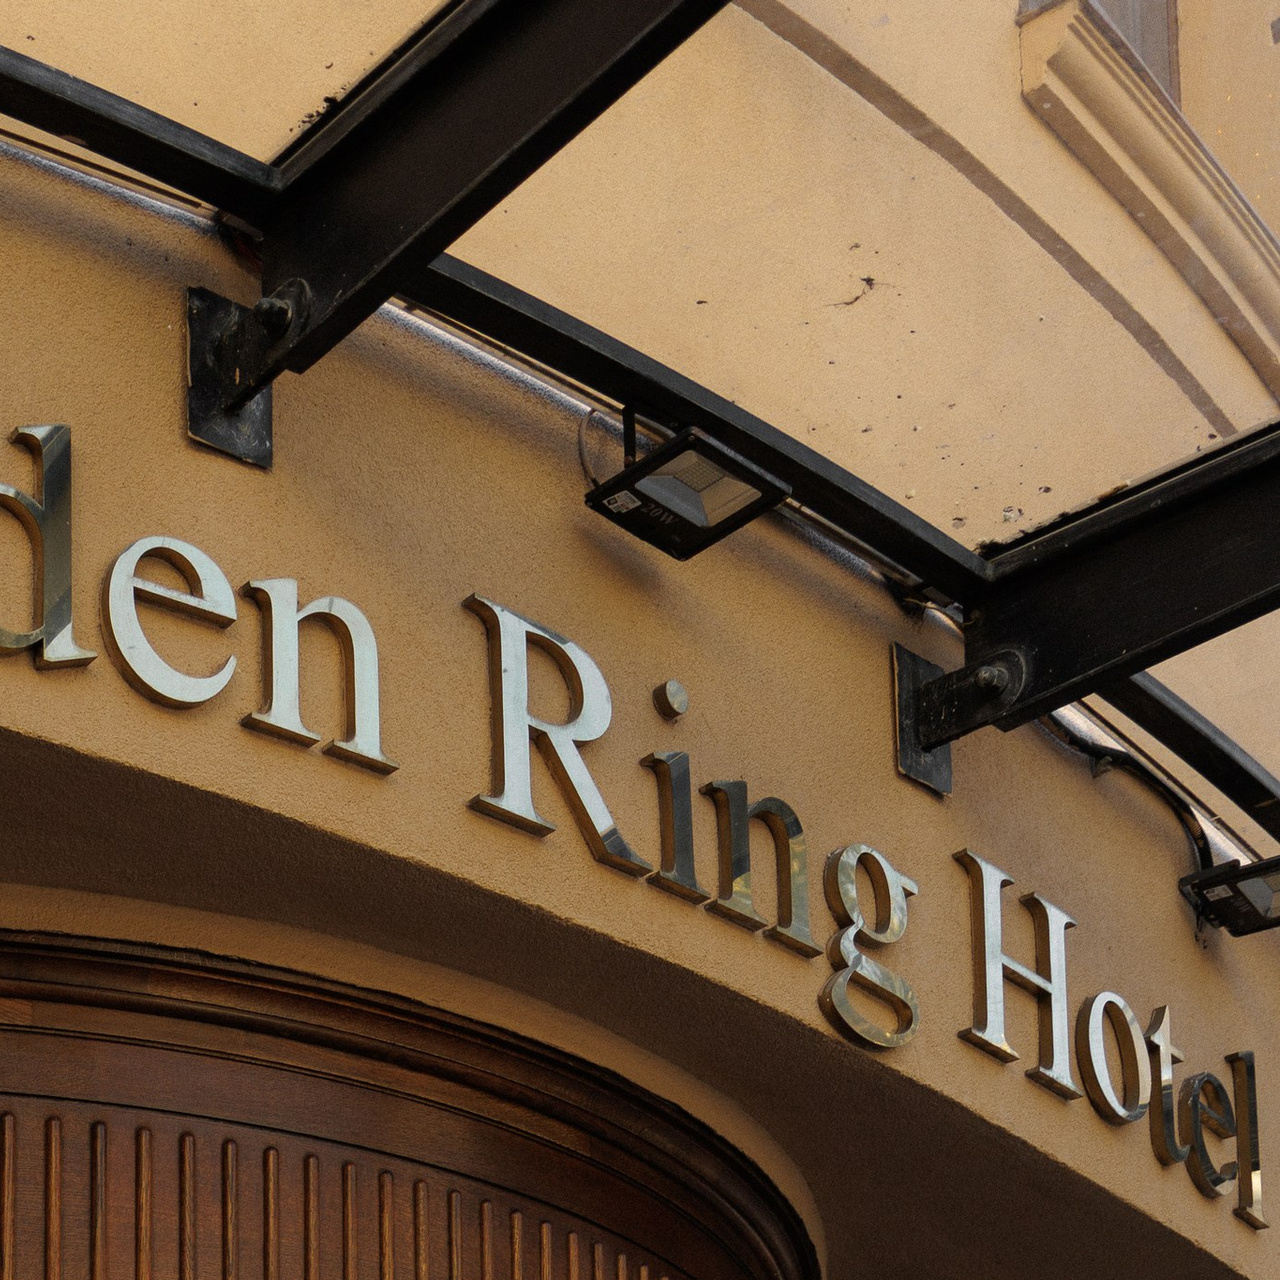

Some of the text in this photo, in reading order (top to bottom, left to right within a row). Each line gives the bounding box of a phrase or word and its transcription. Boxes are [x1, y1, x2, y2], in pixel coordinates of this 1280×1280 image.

[641, 502, 679, 525] 20W
[463, 592, 920, 1049] Ring
[952, 848, 1269, 1230] Hotel
